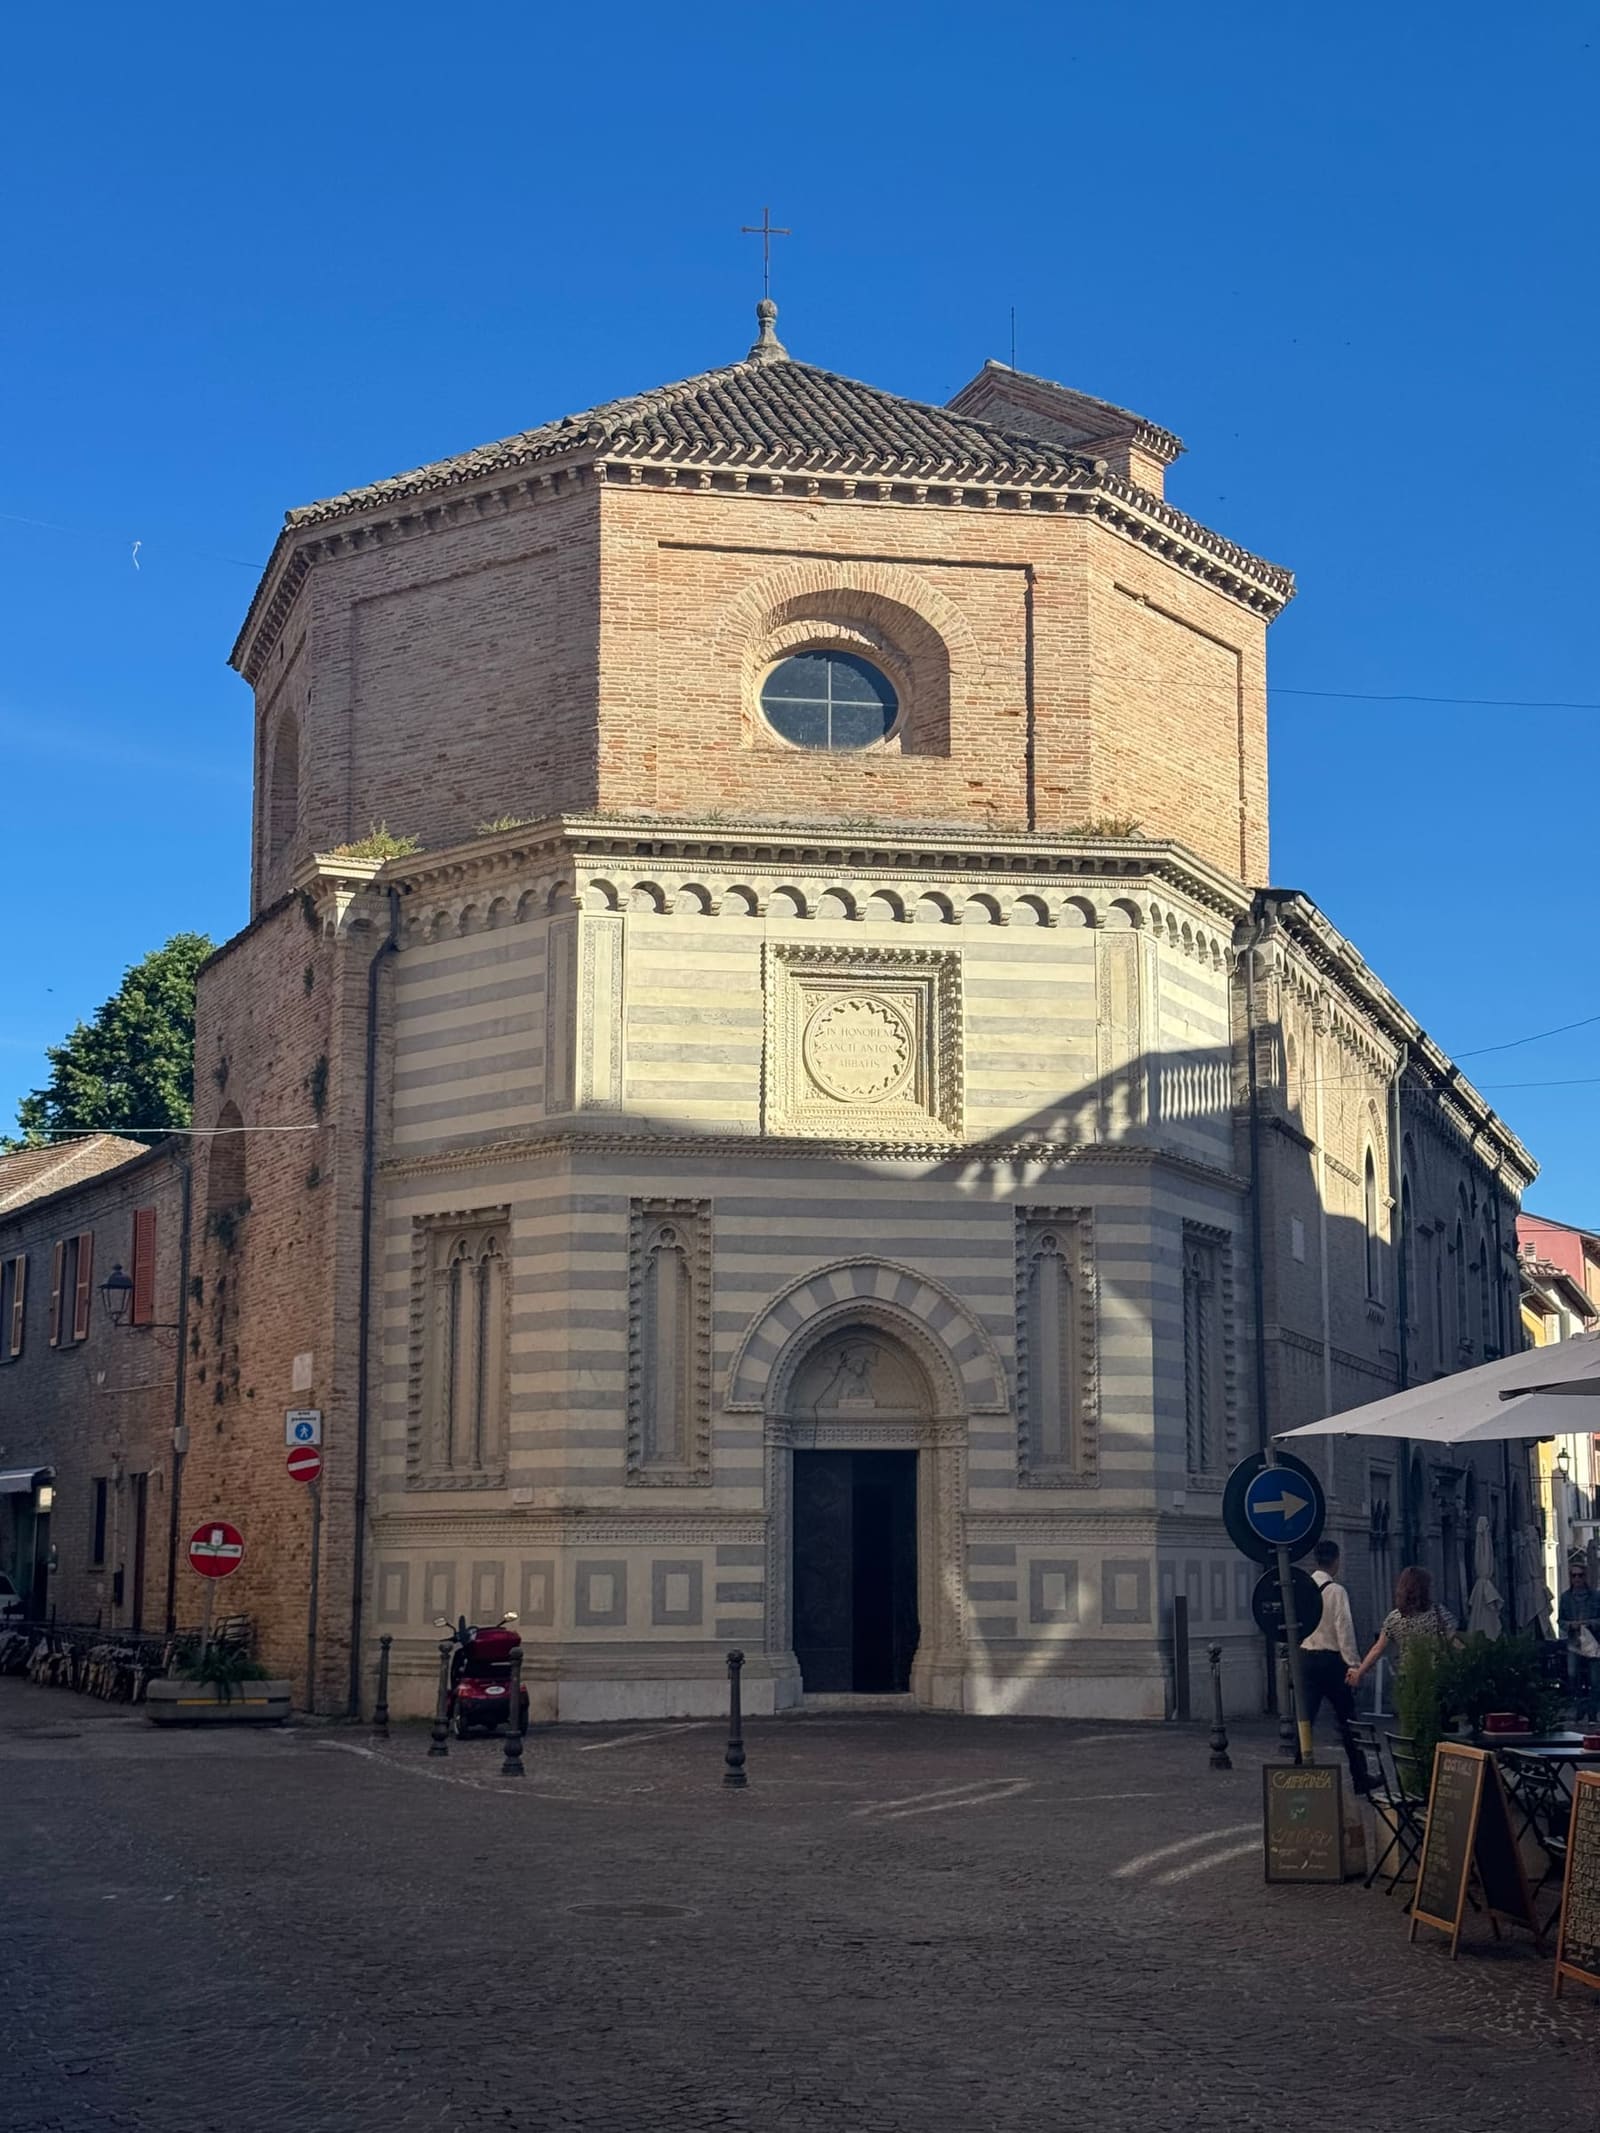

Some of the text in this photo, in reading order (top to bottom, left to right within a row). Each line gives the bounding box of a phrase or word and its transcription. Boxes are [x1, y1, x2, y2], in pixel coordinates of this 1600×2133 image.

[826, 1026, 893, 1038] IN HONOREM
[822, 1043, 856, 1052] SANCTI
